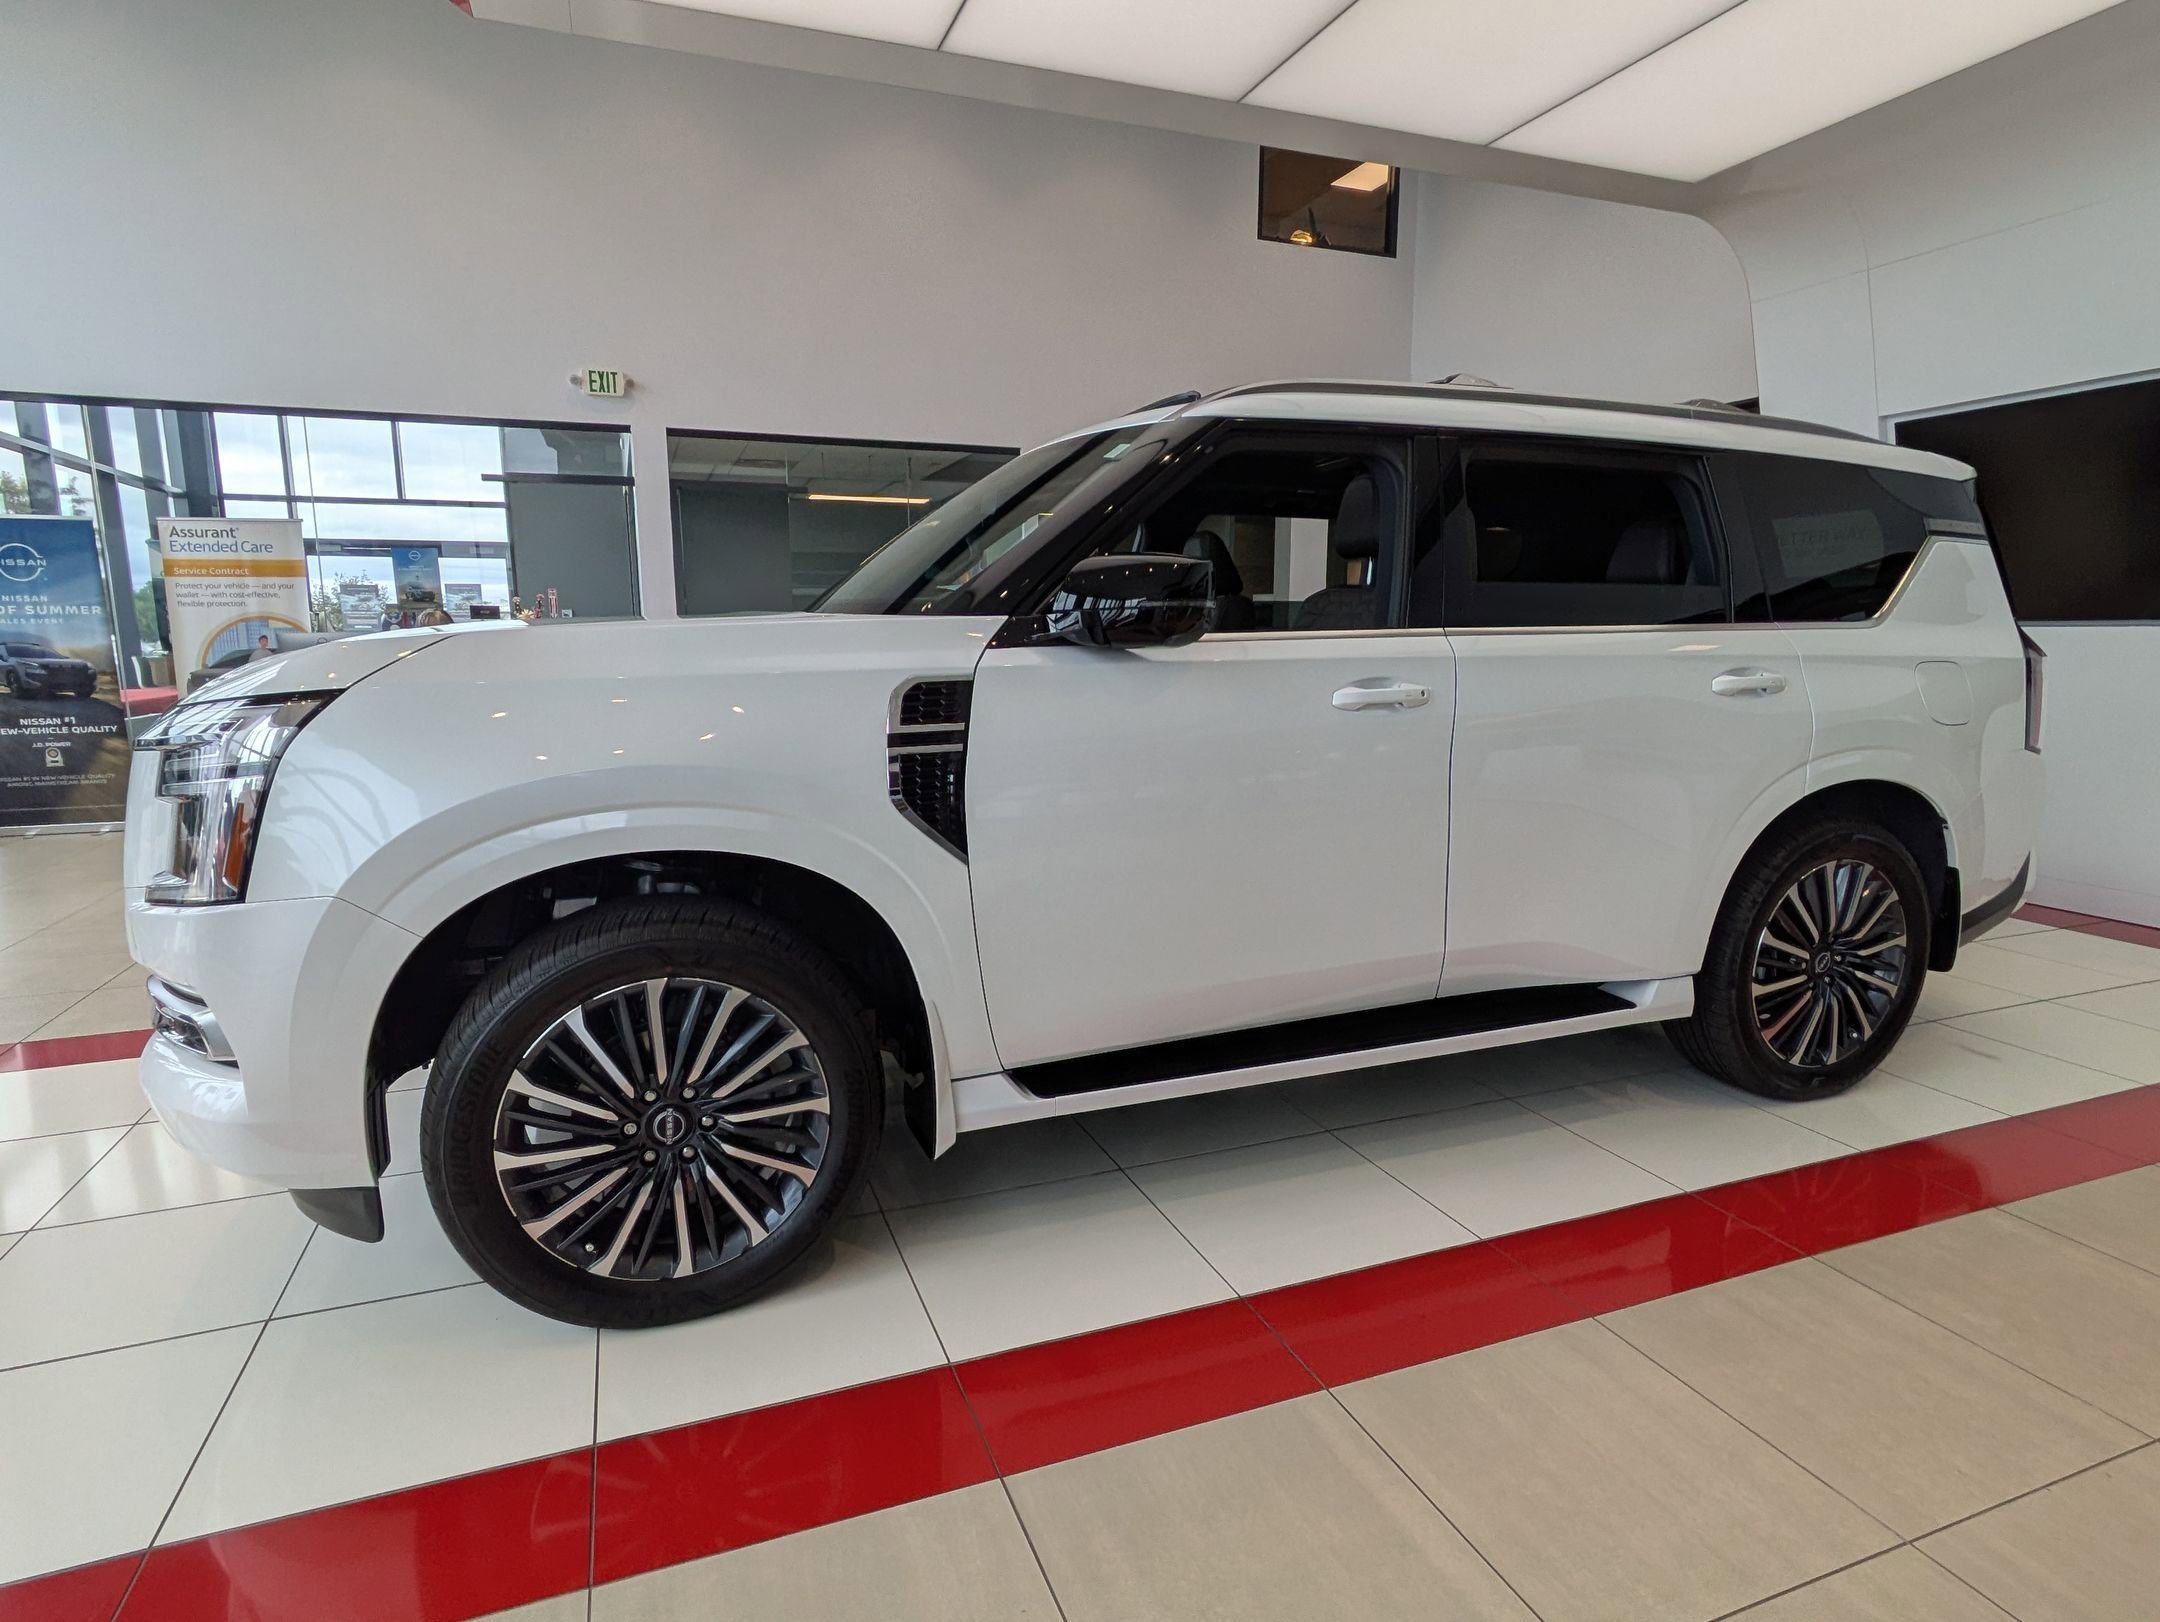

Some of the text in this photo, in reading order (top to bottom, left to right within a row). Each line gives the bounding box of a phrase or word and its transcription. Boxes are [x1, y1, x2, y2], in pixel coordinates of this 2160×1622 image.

[588, 370, 618, 393] EXIT
[169, 526, 237, 539] Assurant
[169, 540, 273, 553] Extended Care
[173, 567, 249, 576] Service Contract
[175, 582, 202, 590] Protect
[204, 583, 221, 591] your
[223, 582, 250, 590] vehicle
[261, 582, 276, 590] and
[277, 583, 295, 591] your
[176, 591, 199, 599] wallet
[210, 591, 228, 599] with
[177, 600, 205, 608] flexible
[25, 605, 102, 615] SUMMER
[19, 717, 61, 726] NISSAN
[71, 725, 118, 734] QUALITY
[665, 1108, 674, 1145] NISSAN
